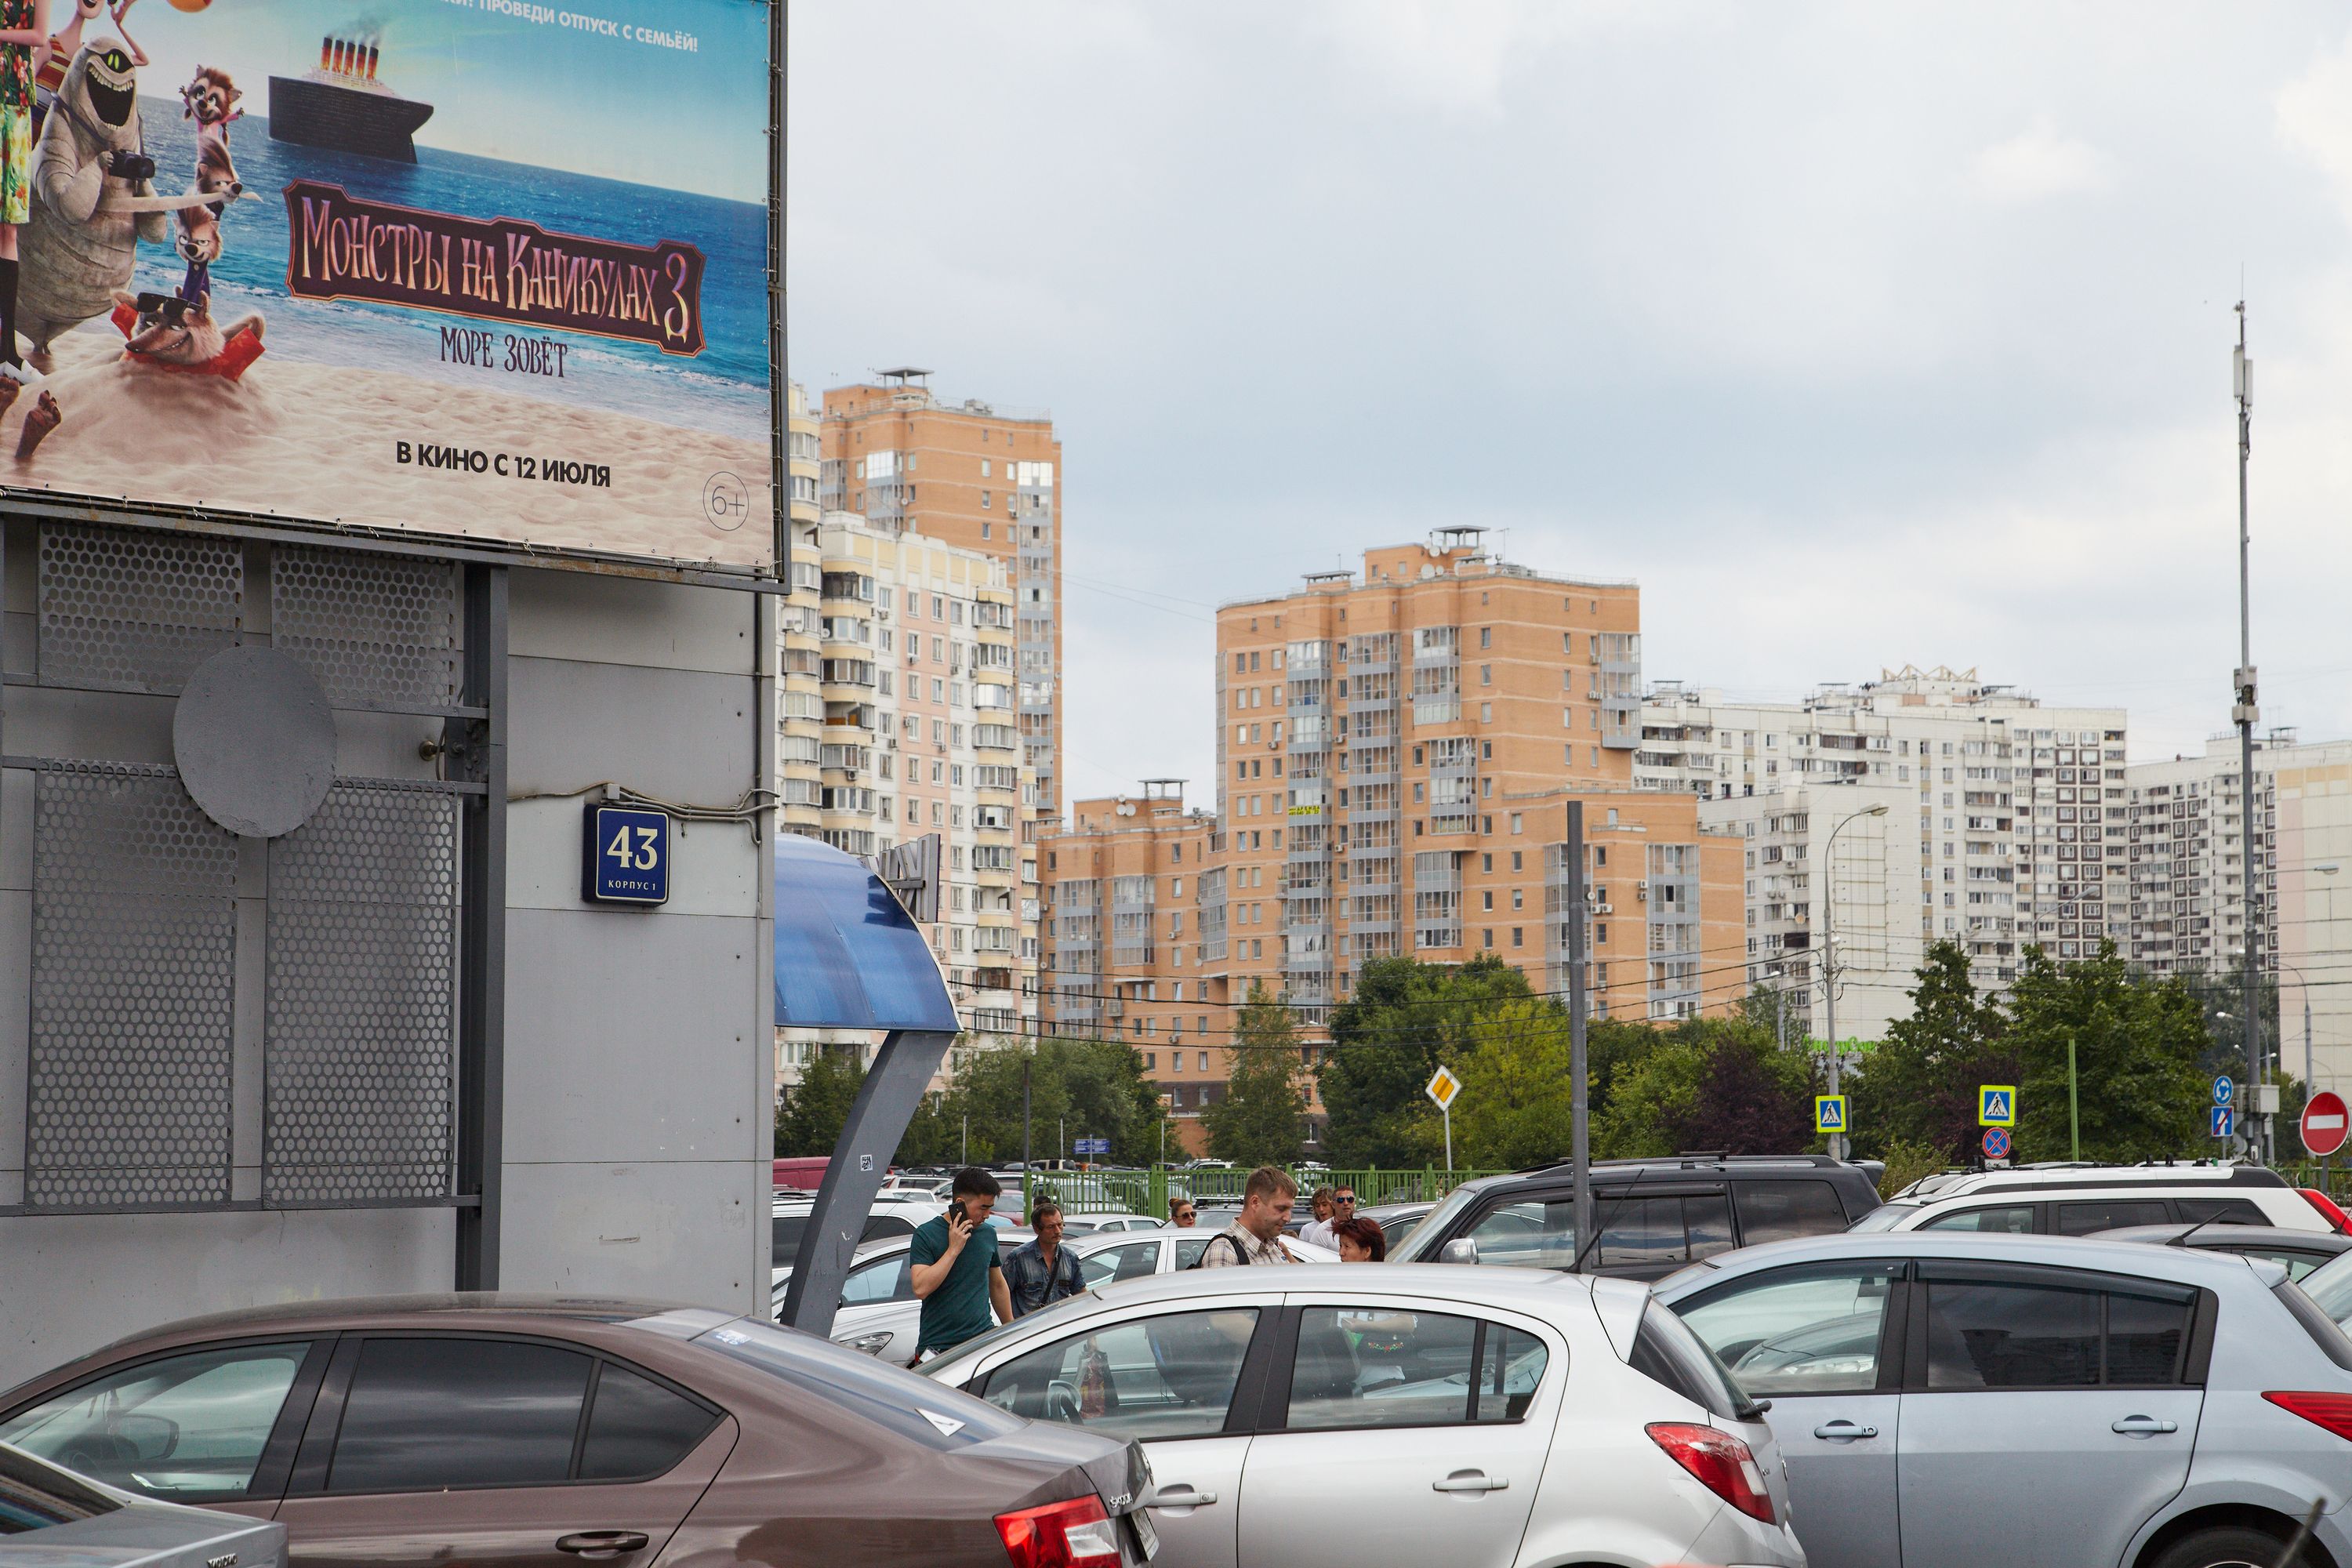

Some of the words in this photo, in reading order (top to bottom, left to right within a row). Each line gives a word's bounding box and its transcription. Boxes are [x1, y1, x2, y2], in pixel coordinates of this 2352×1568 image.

[479, 0, 554, 24] ПРОВЕДИ
[558, 12, 619, 37] ОТПУСК
[622, 24, 632, 40] С
[636, 30, 699, 53] СЕМЬЁЙ!
[664, 252, 690, 344] 3
[441, 325, 494, 368] МОРЕ
[504, 334, 568, 378] ЗОВЁТ
[397, 441, 412, 464] В
[418, 444, 488, 473] КИНО
[494, 454, 508, 476] С
[514, 456, 536, 480] 12
[543, 459, 611, 488] ИЮЛЯ
[711, 485, 745, 517] 6+
[607, 826, 658, 870] 43
[608, 880, 649, 891] КОРПУС
